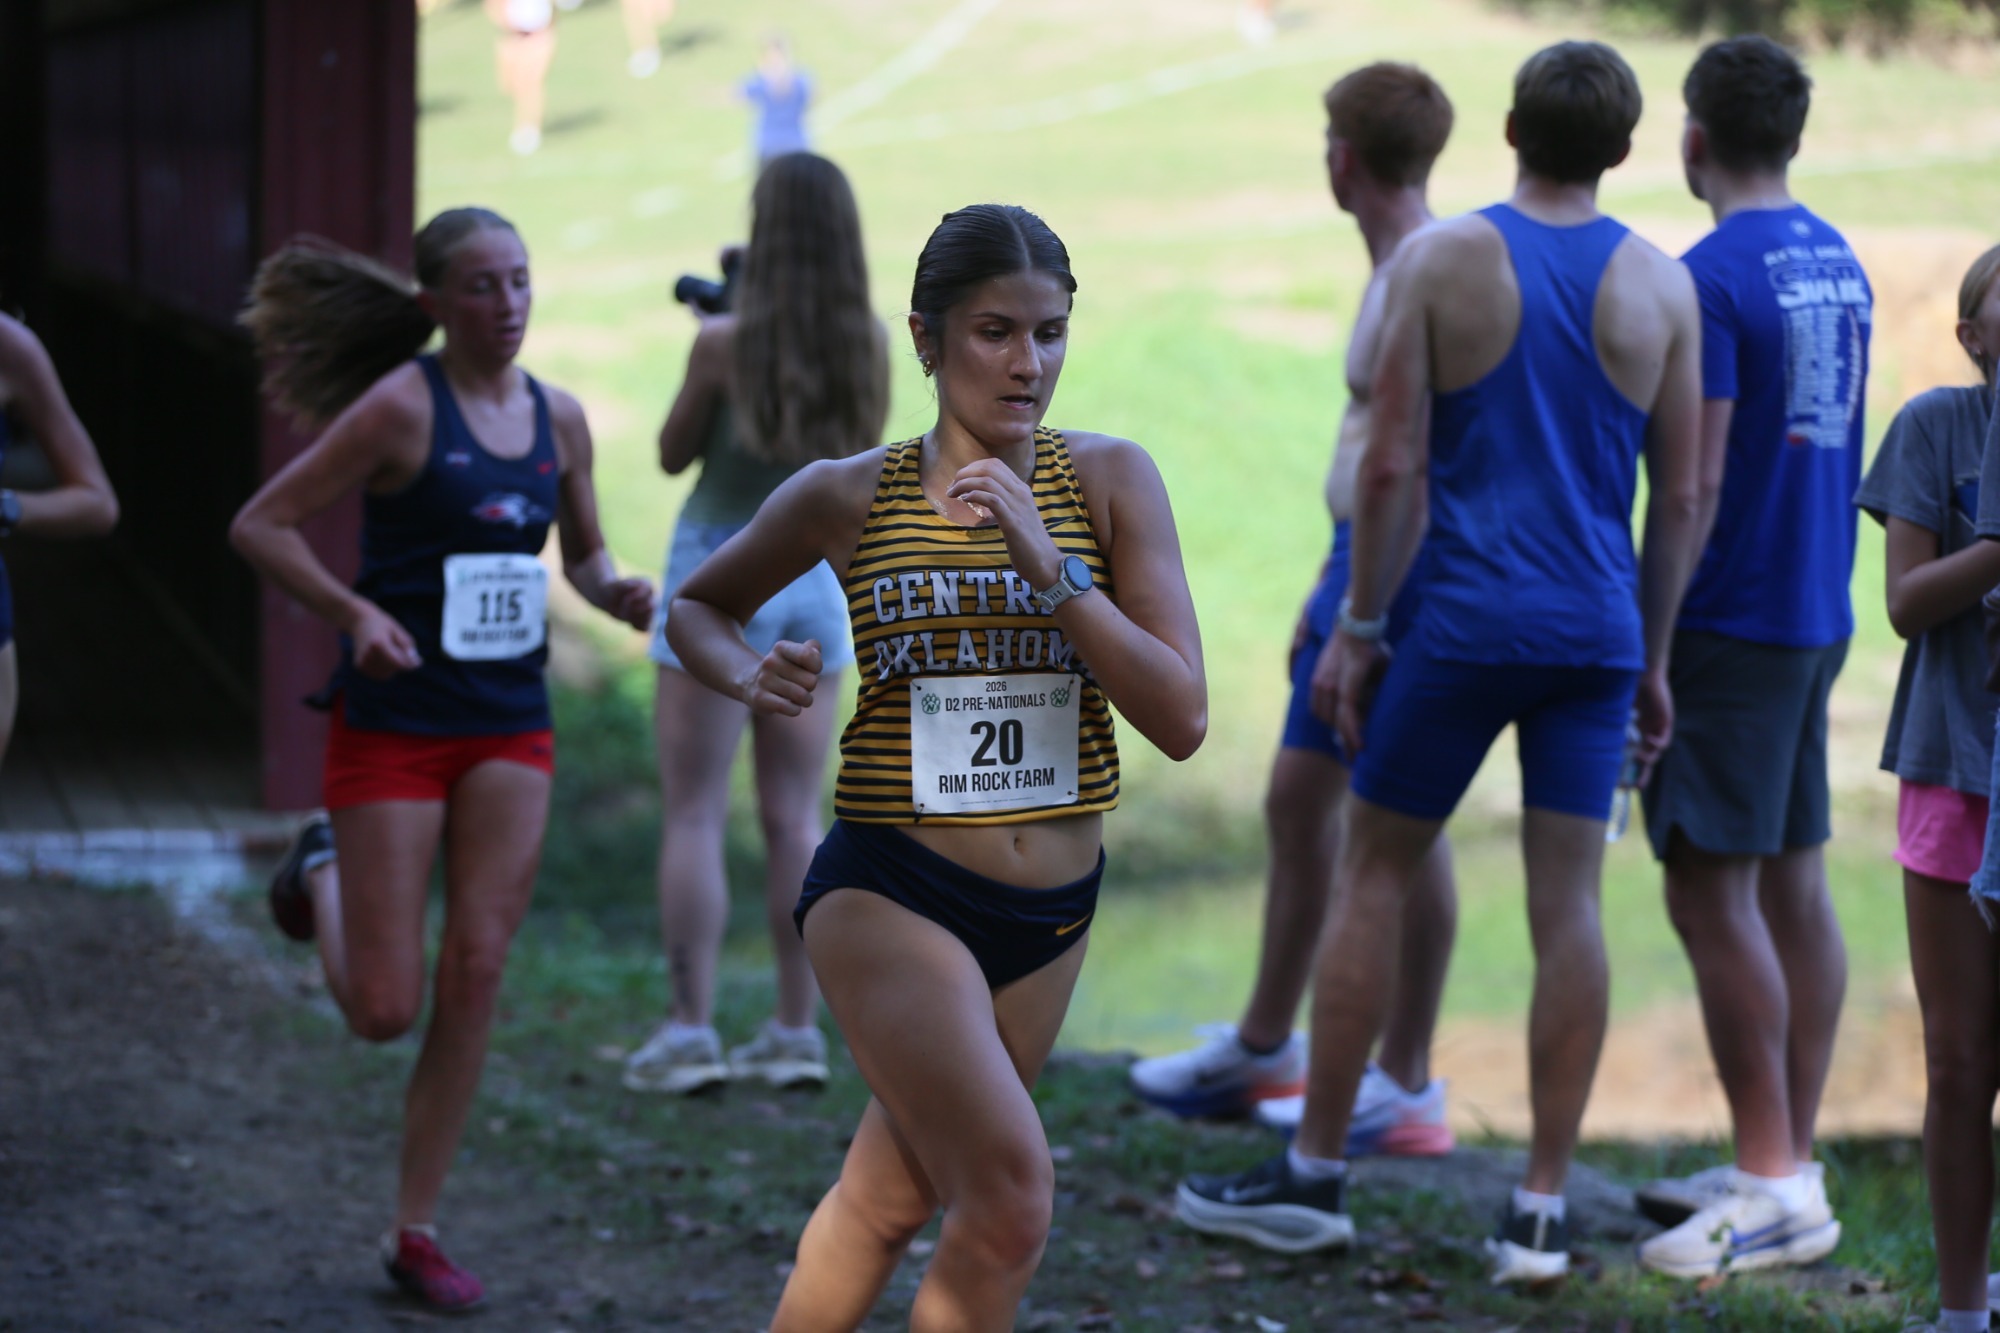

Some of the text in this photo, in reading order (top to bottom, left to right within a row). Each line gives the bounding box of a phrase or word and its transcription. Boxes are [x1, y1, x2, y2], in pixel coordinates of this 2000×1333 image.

[478, 588, 525, 625] 115
[873, 570, 1053, 623] CENTR
[873, 628, 1092, 680] OKLAHOM
[945, 693, 1046, 711] D2 PRE-NATIONALS
[985, 681, 1007, 692] 2026
[970, 719, 1023, 767] 20
[939, 767, 1055, 793] RIM ROCK FARM
